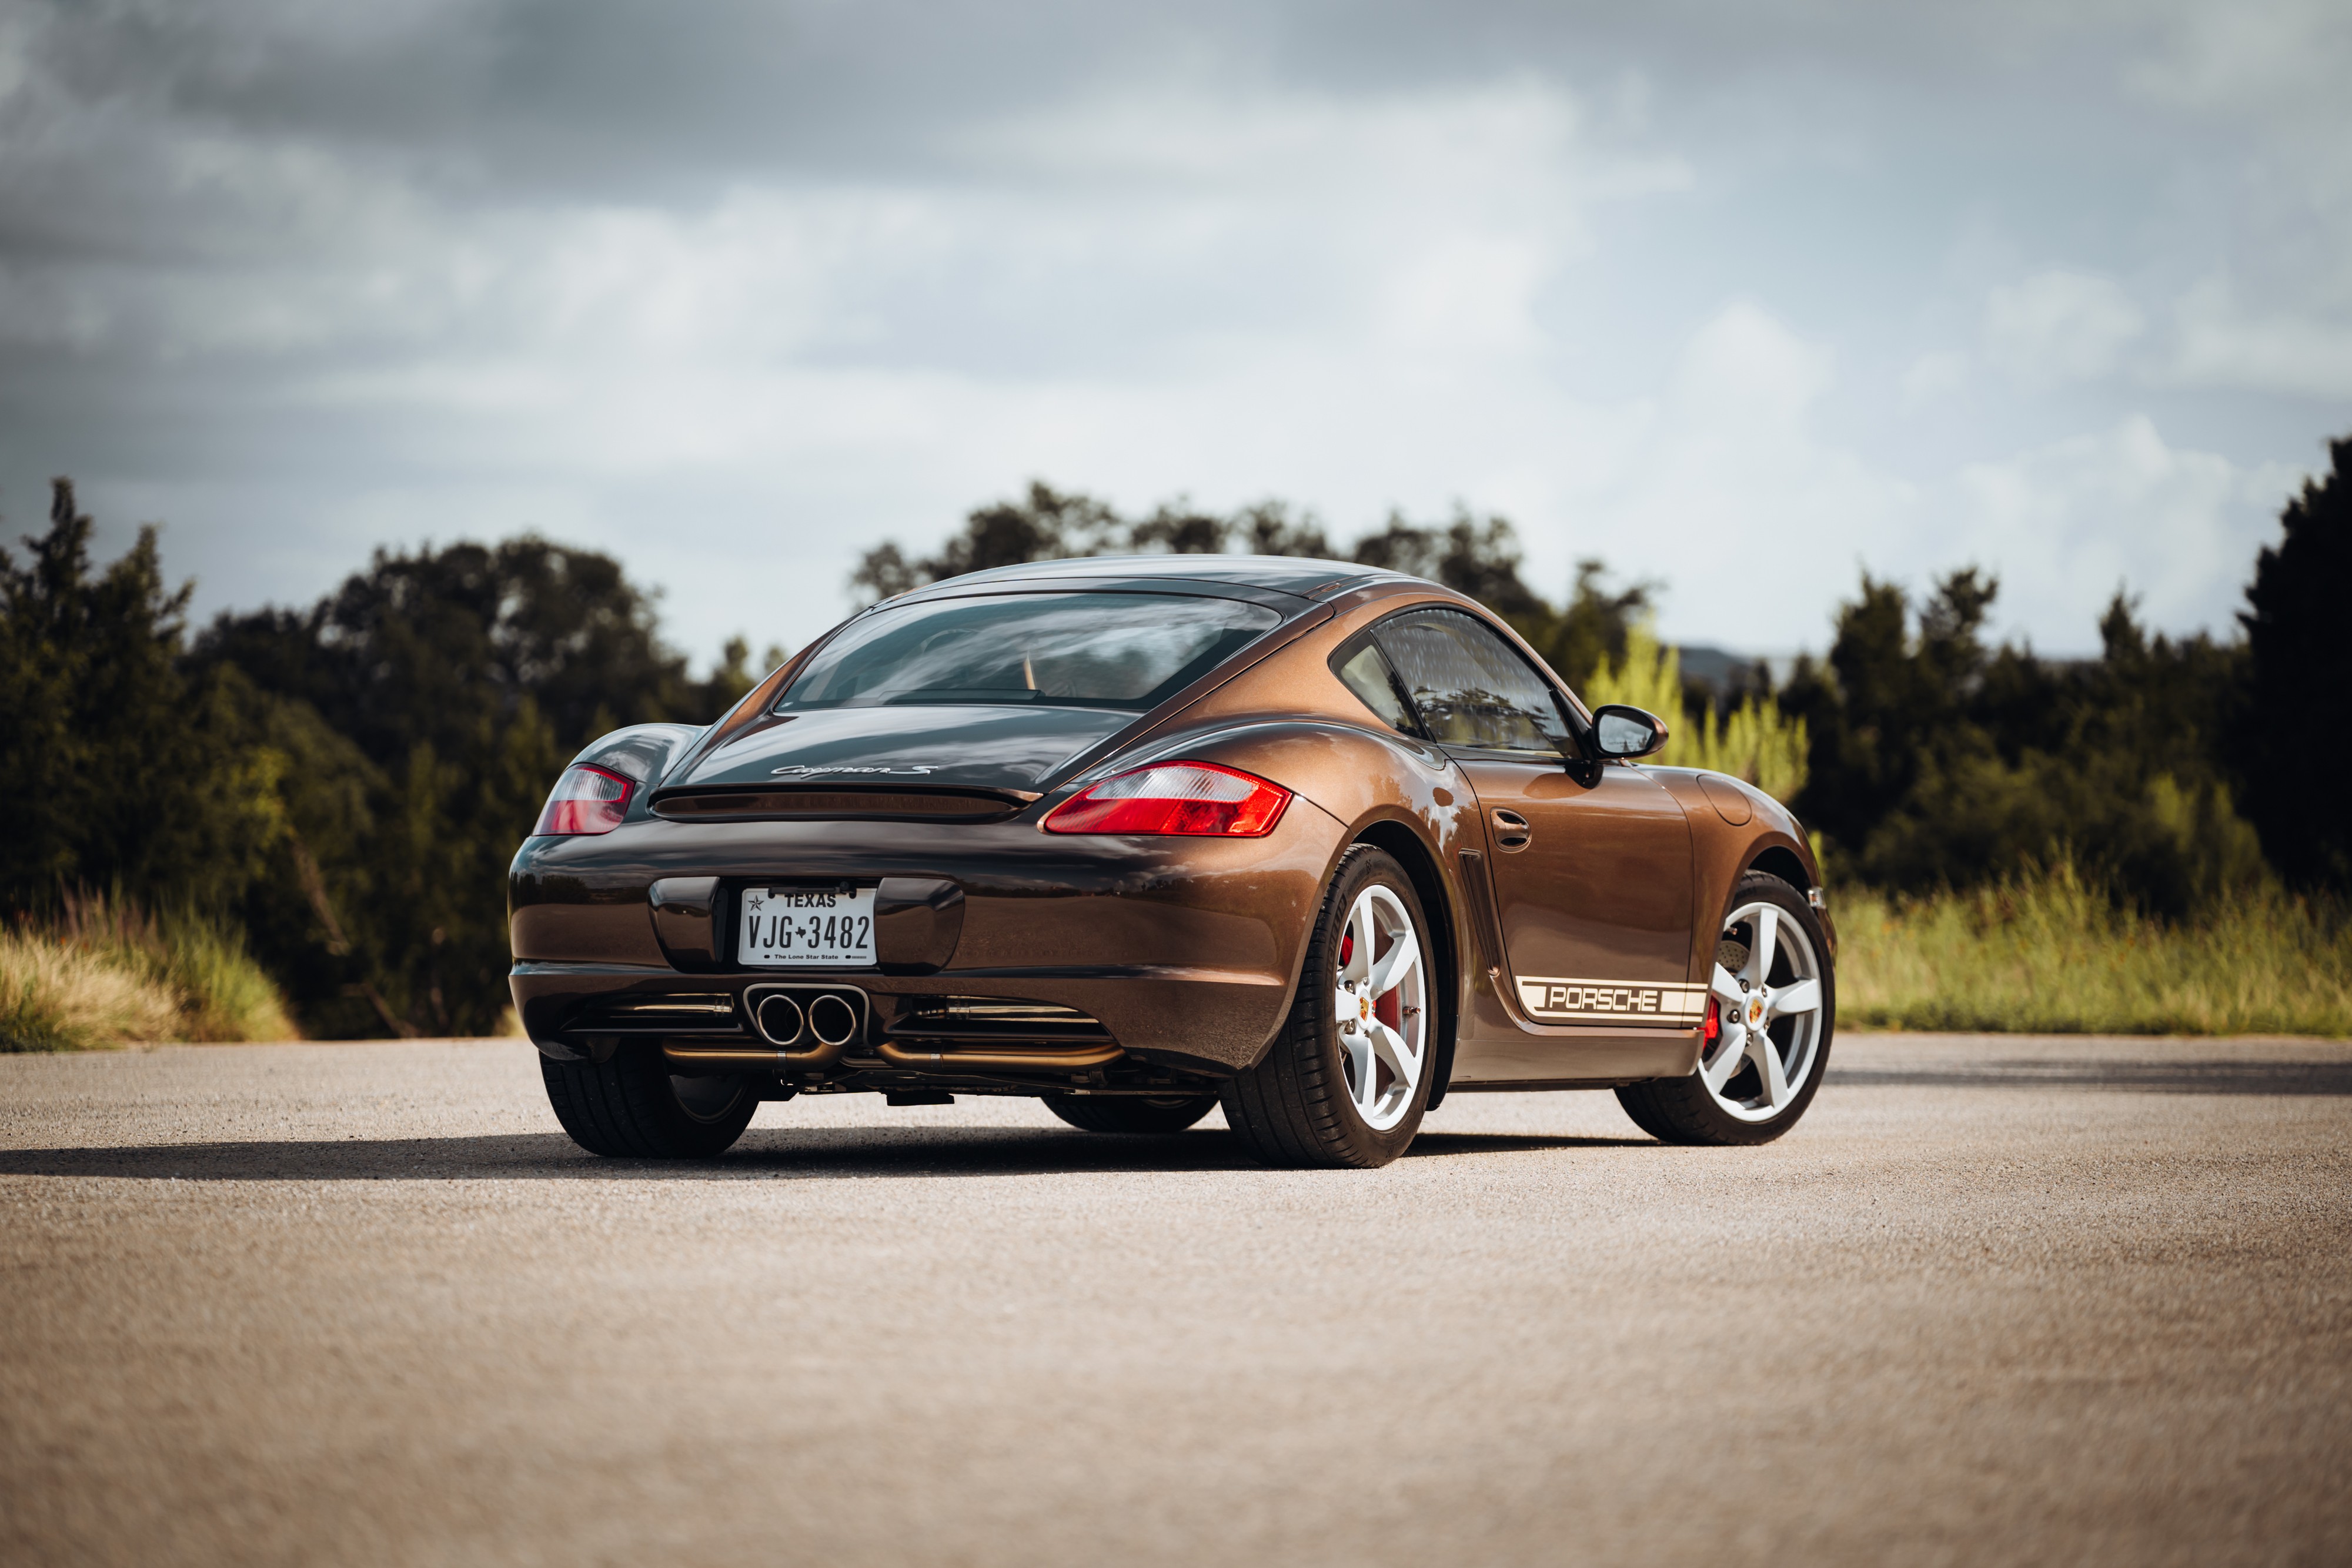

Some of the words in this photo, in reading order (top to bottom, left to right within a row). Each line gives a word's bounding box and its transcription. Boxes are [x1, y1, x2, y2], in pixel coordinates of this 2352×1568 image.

[770, 765, 890, 779] Cayman
[888, 765, 938, 775] S
[784, 894, 836, 907] TEXAS
[1549, 987, 1658, 1012] PORSCHE
